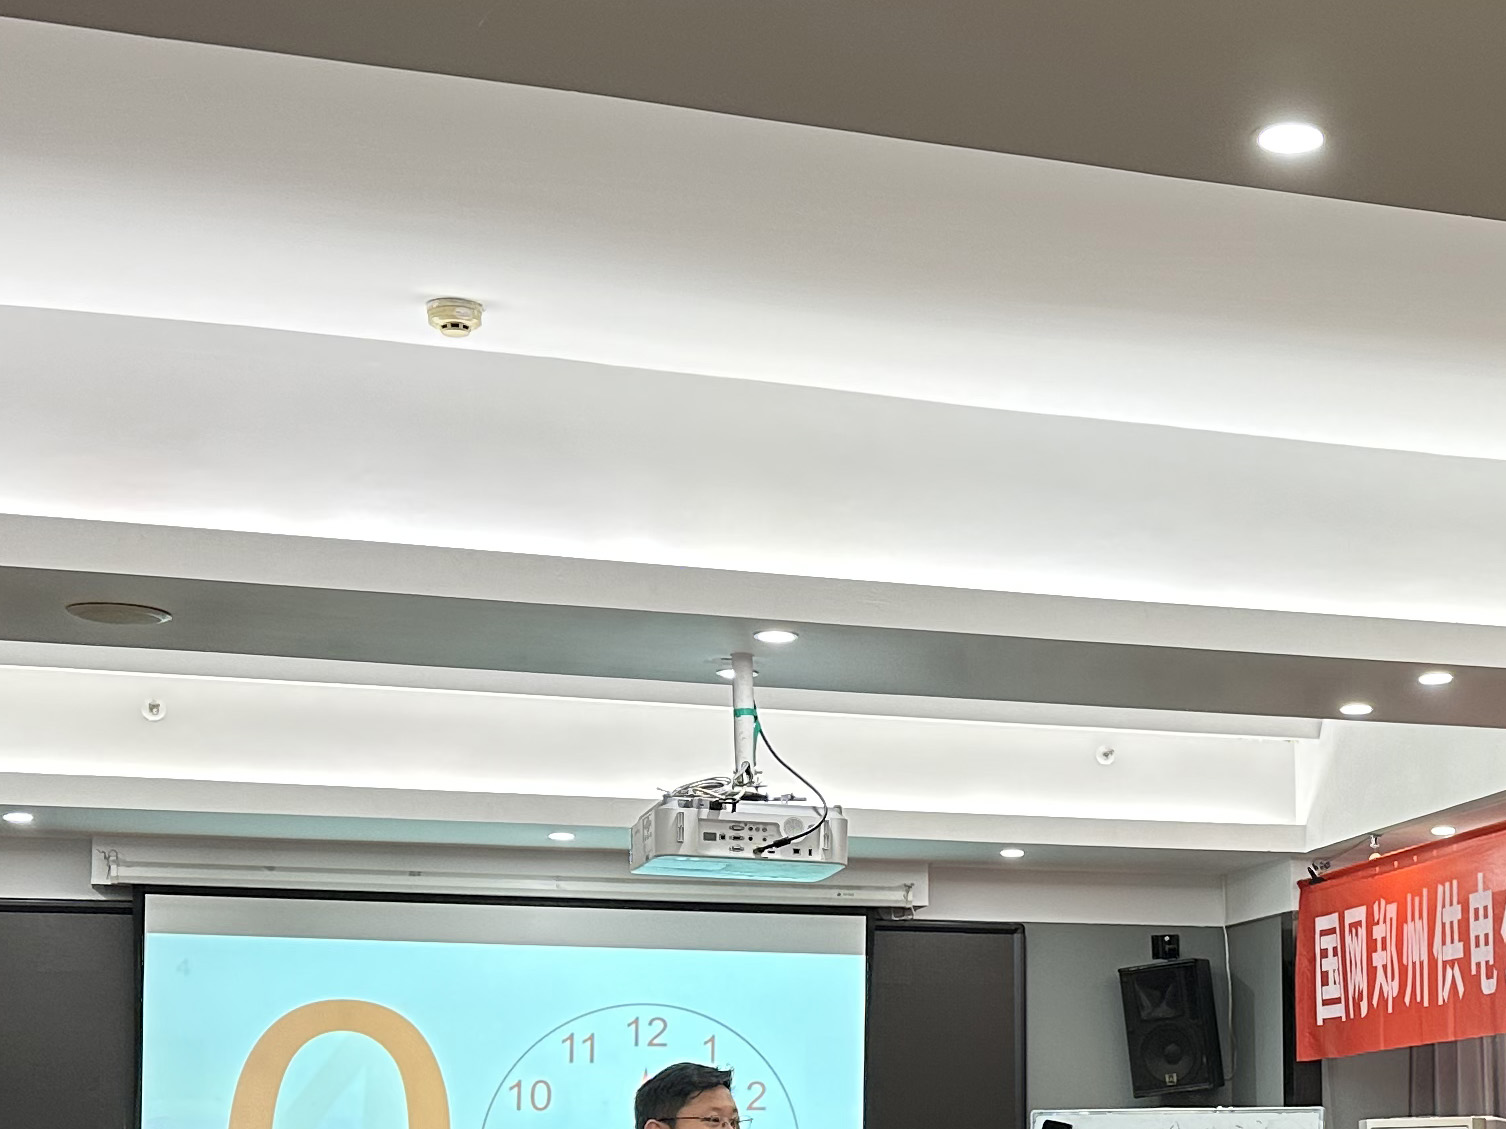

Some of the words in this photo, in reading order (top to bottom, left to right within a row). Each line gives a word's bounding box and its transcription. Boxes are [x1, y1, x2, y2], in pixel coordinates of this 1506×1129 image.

[626, 1016, 668, 1047] 12
[561, 1032, 596, 1064] 11
[703, 1035, 716, 1063] 1
[508, 1079, 552, 1112] 10
[746, 1081, 766, 1111] 2
